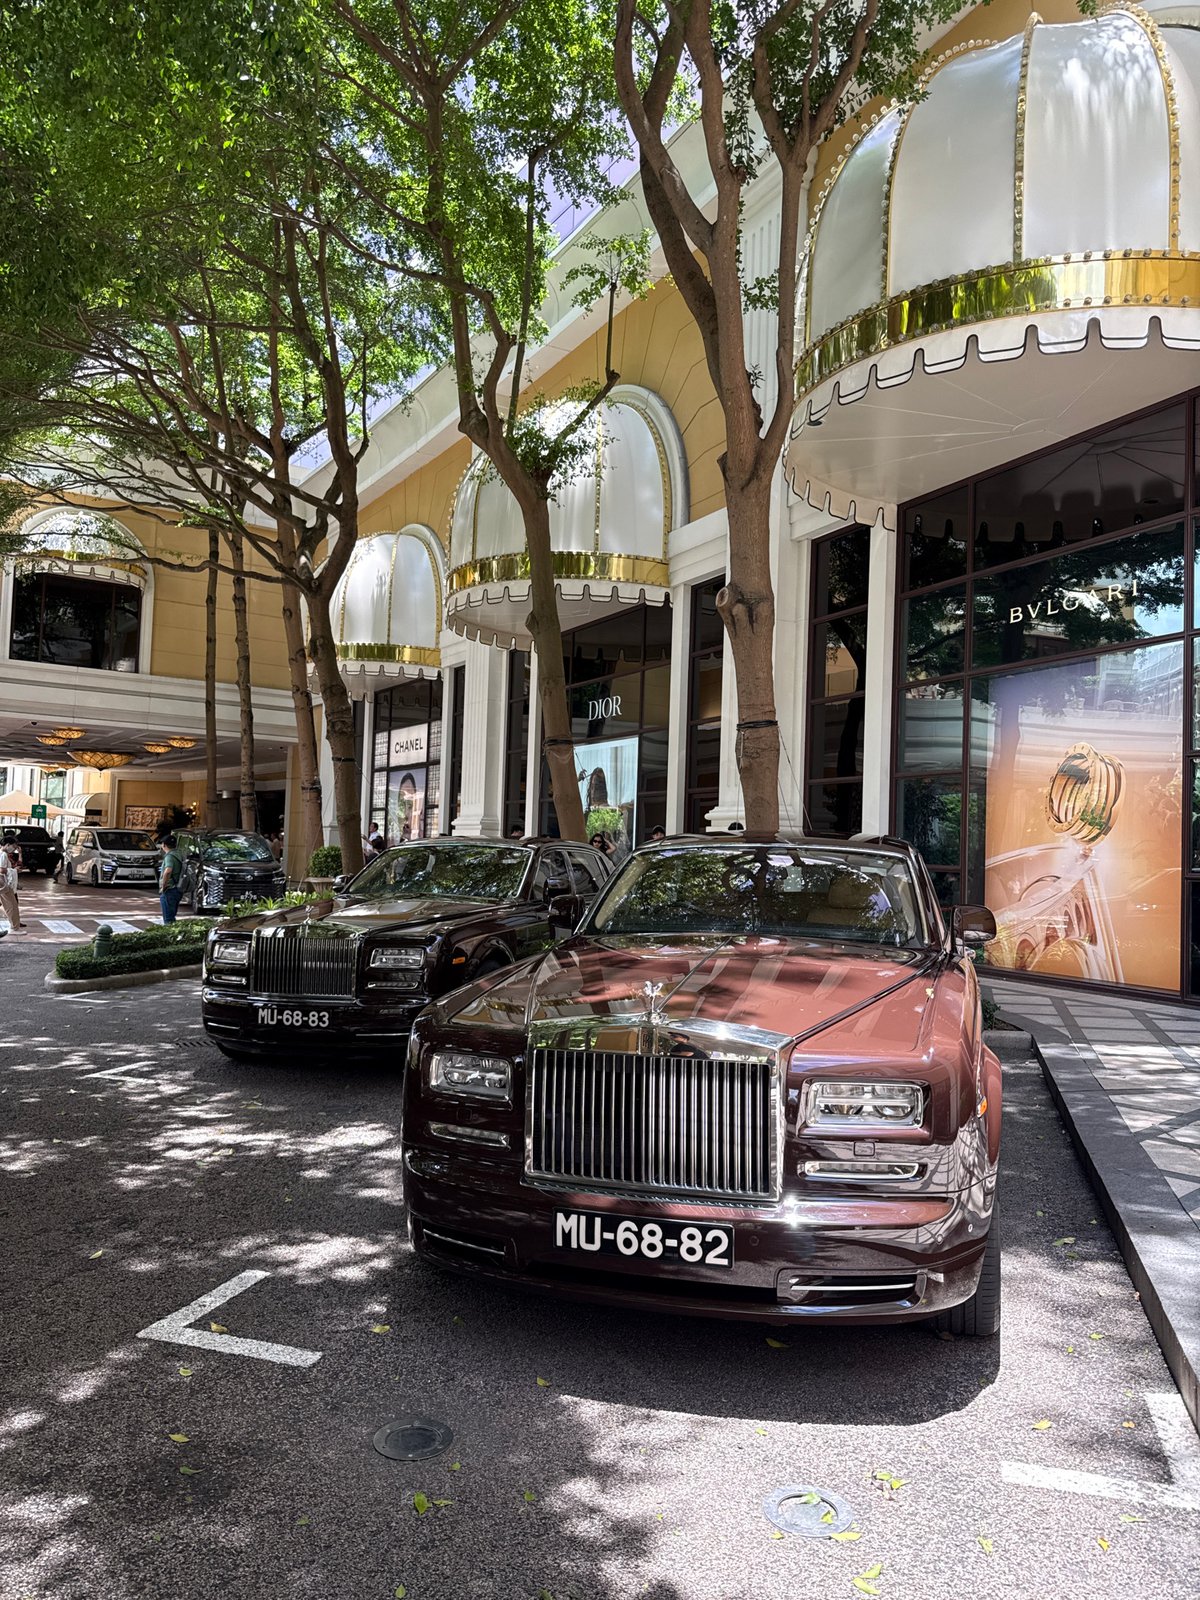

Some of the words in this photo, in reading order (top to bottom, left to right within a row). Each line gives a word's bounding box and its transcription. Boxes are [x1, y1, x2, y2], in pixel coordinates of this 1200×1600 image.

[1009, 579, 1139, 624] BVLGARI
[588, 695, 622, 721] DIOR
[394, 737, 424, 754] CHANEL
[258, 1008, 329, 1027] MU-68-83
[556, 1212, 729, 1266] MU-68-82
